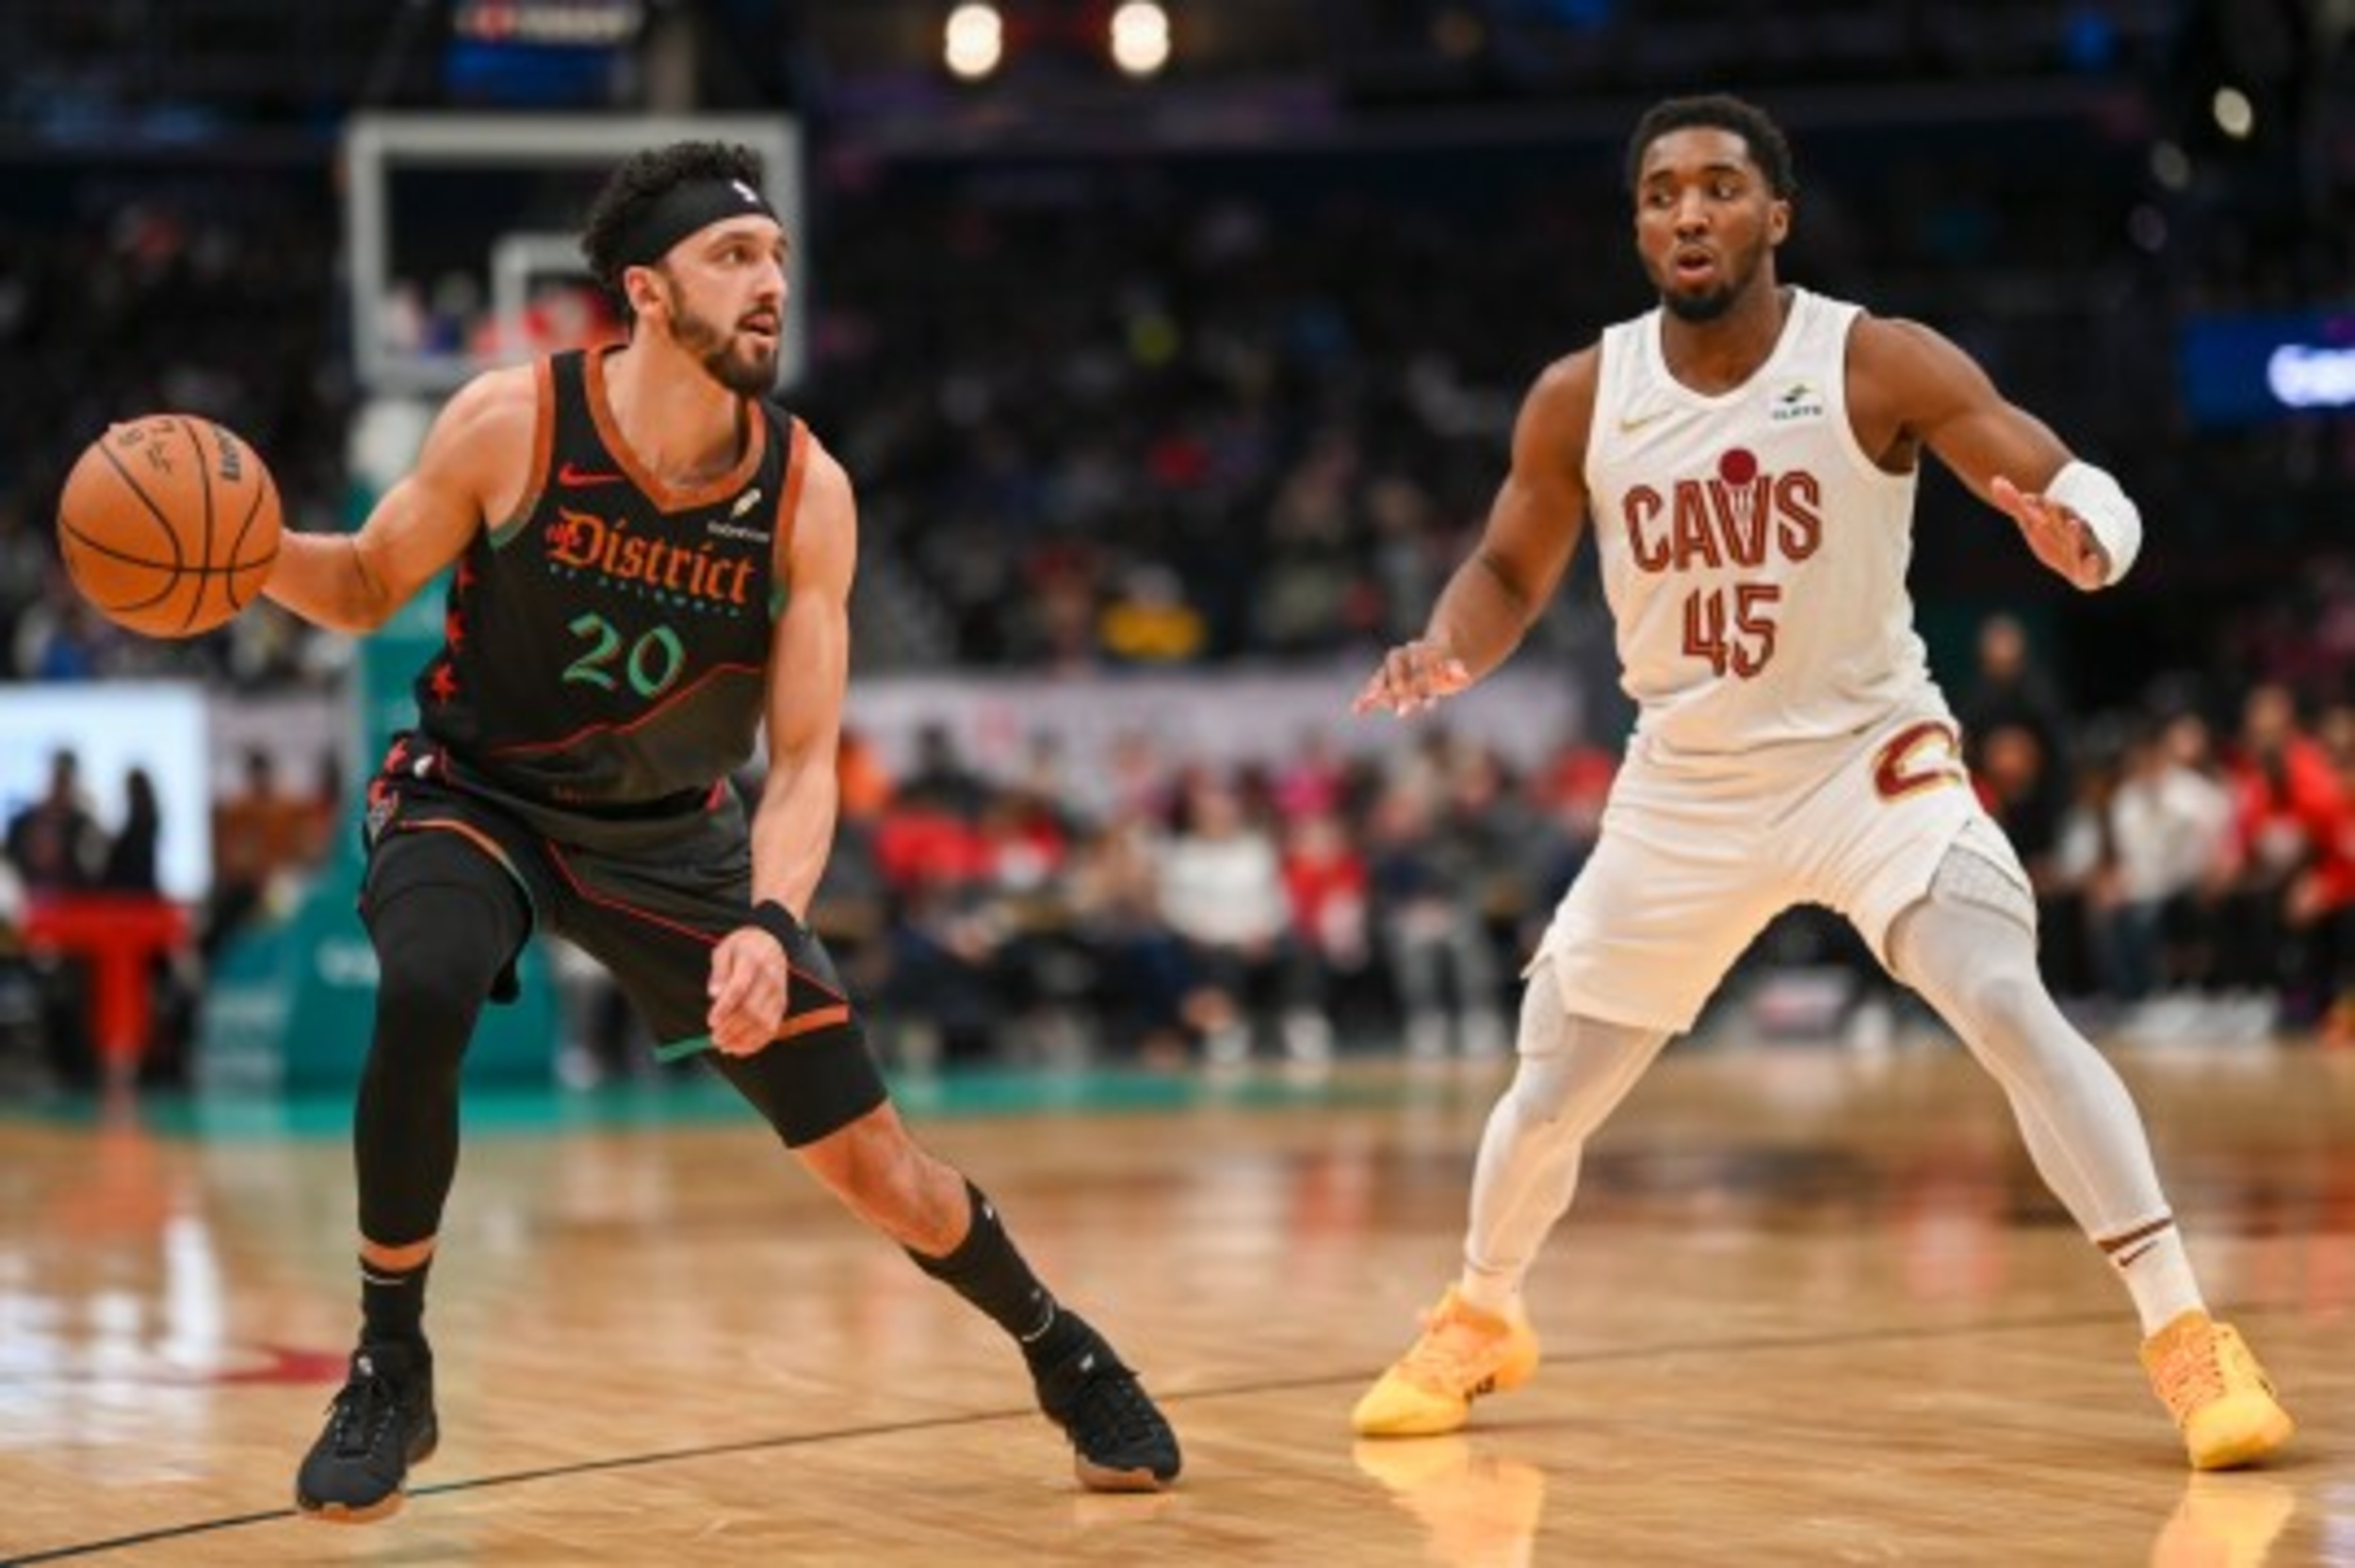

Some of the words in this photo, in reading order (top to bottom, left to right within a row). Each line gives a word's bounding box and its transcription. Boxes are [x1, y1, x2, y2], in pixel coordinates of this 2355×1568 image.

[546, 507, 755, 604] District
[1622, 470, 1822, 573] CAVS
[562, 611, 686, 698] 20
[1681, 583, 1781, 678] 45
